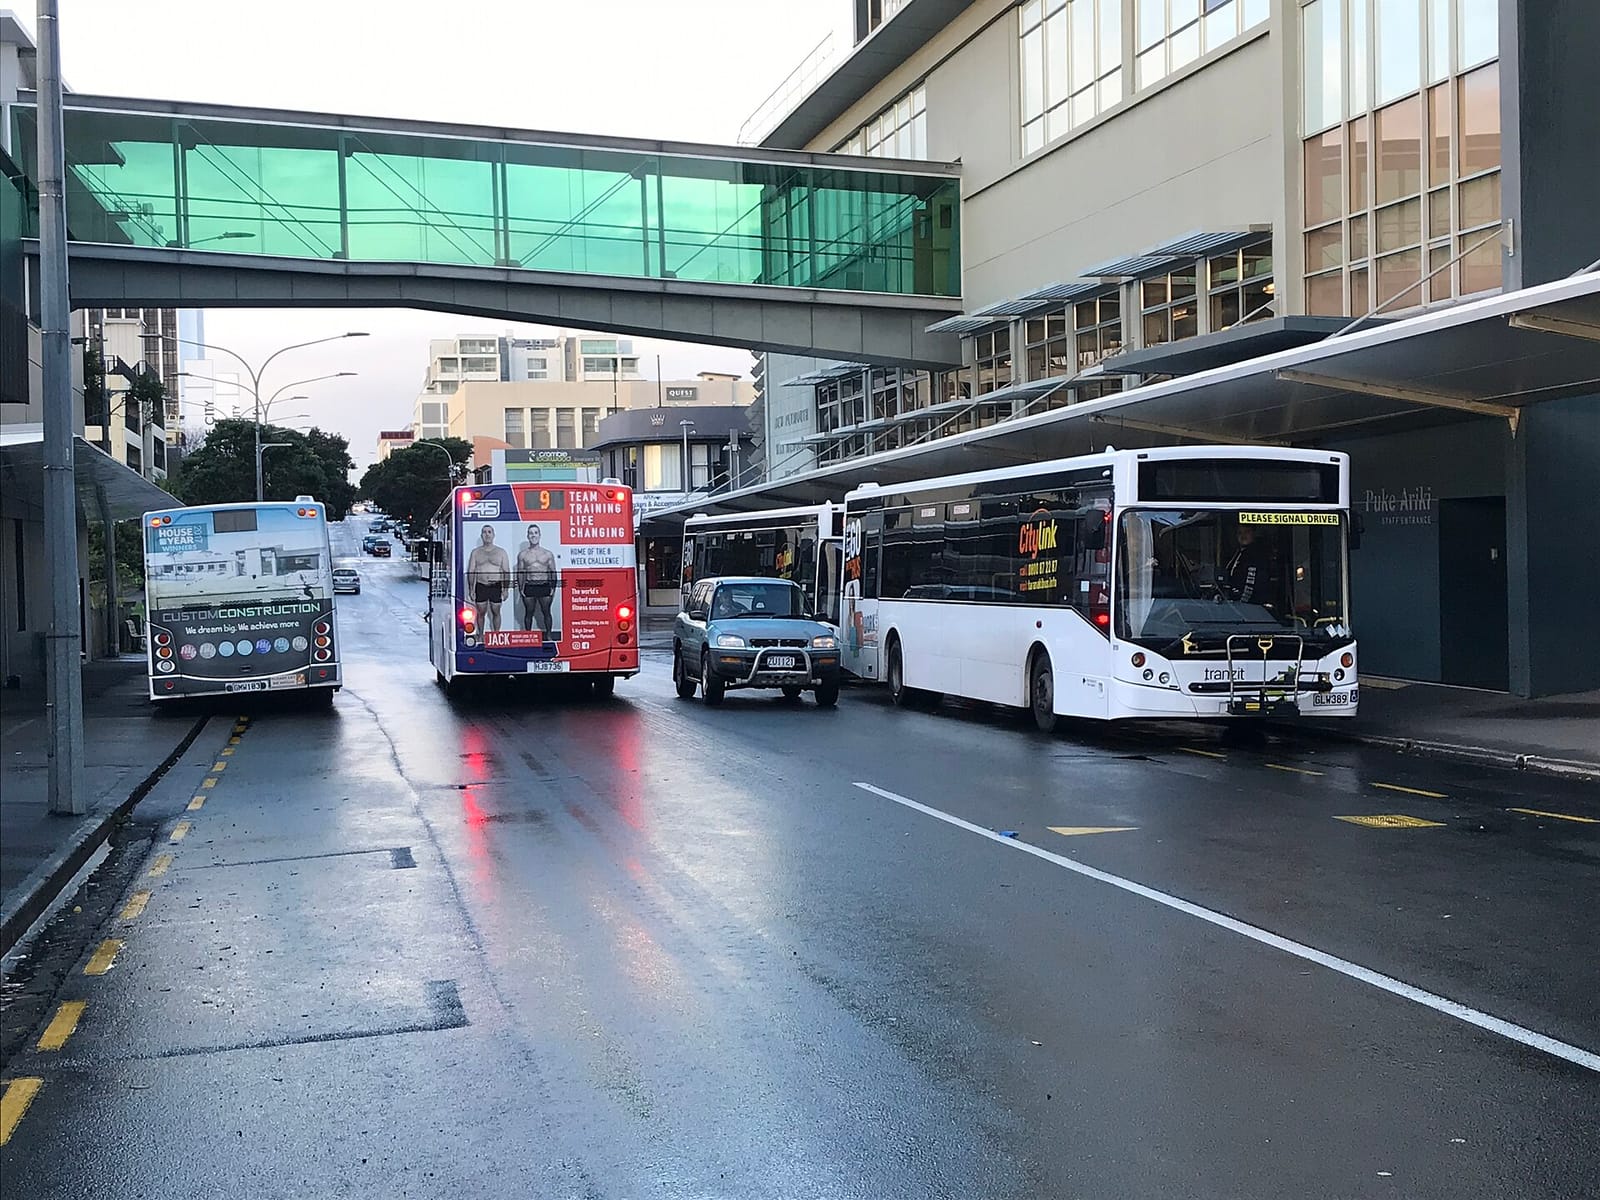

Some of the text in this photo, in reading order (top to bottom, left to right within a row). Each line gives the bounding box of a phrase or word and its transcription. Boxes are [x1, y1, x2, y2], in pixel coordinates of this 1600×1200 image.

[669, 389, 693, 397] QUEST
[204, 400, 214, 425] CITY
[540, 490, 550, 510] 9
[569, 491, 598, 502] TEAM
[1366, 486, 1432, 512] Puke Ariki
[463, 500, 500, 517] F45
[569, 503, 622, 514] TRAINING
[569, 515, 594, 526] LIFE
[1241, 513, 1338, 524] PLEASE SIGNAL DRIVER
[159, 527, 193, 538] HOUSE
[570, 527, 625, 538] CHANGING
[167, 536, 194, 545] YEAR
[1019, 518, 1058, 560] Citylink
[570, 547, 586, 555] HOME
[588, 547, 594, 555] OF
[596, 547, 606, 555] THE
[571, 556, 619, 565] WEEK CHALLENGE
[185, 620, 300, 635] We dream big. We achieve more
[488, 632, 510, 646] JACK
[1204, 667, 1245, 681] tranzit
[1314, 693, 1347, 705] GLW389
